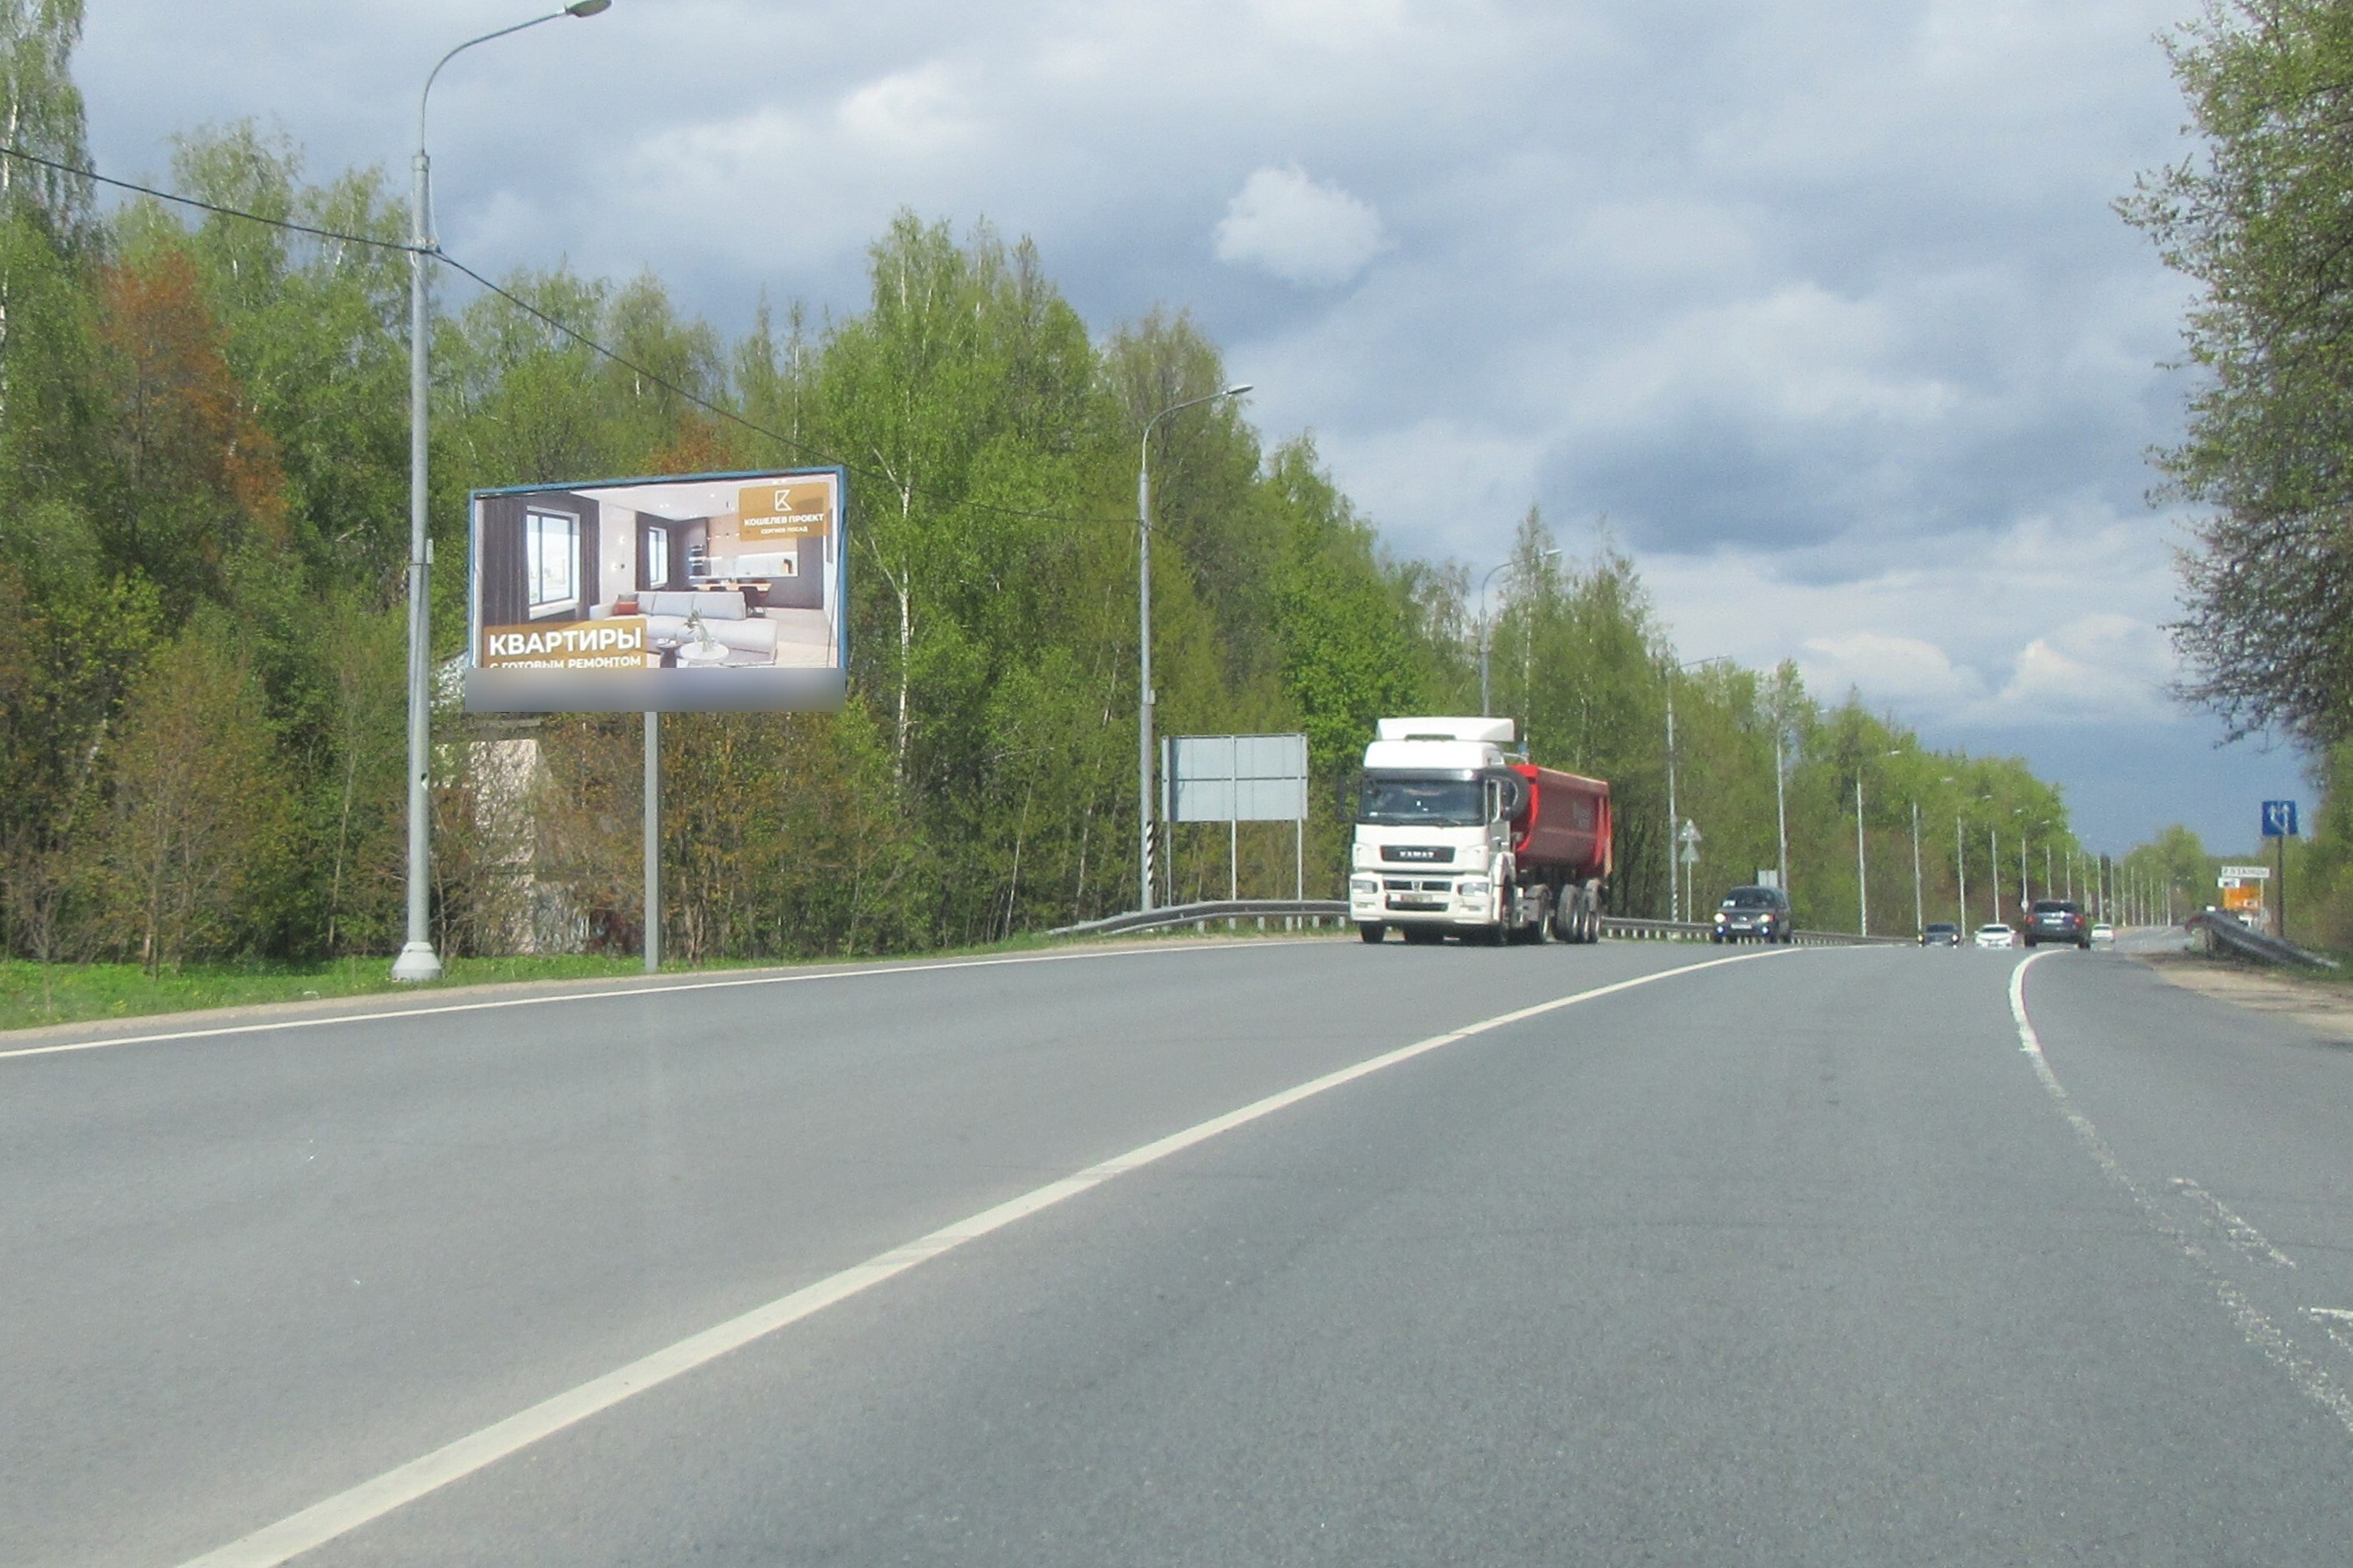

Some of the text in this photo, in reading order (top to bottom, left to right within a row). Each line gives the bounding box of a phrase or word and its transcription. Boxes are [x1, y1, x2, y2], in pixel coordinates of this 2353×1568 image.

[744, 513, 825, 526] КОШЕЛЕВ ПРОЕКТ
[489, 627, 642, 656] КВАРТИРЫ
[568, 655, 641, 668] РЕМОНТОМ
